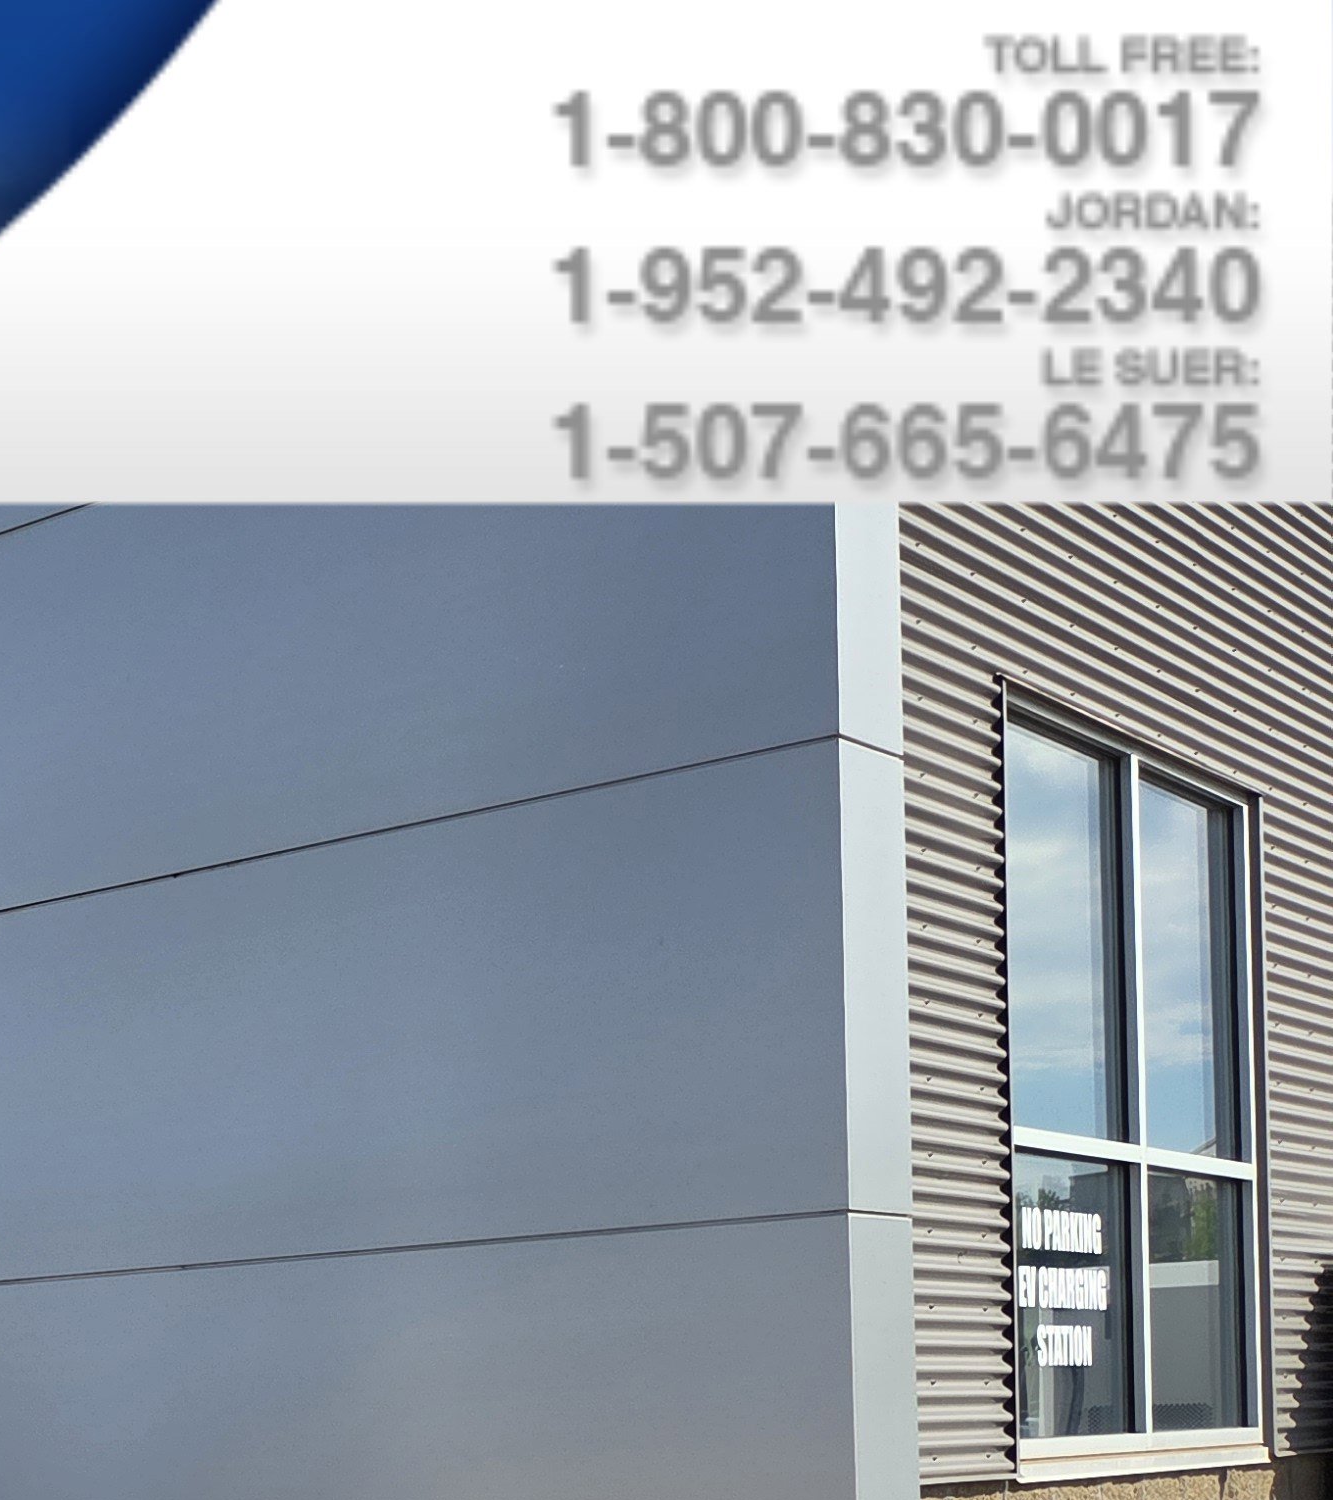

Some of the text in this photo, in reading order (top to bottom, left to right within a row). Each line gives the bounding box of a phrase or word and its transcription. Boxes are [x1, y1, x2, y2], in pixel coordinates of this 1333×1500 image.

[1021, 1207, 1102, 1254] NO PARKING
[1018, 1266, 1107, 1311] EV CHARGING
[1036, 1325, 1092, 1367] STATION
